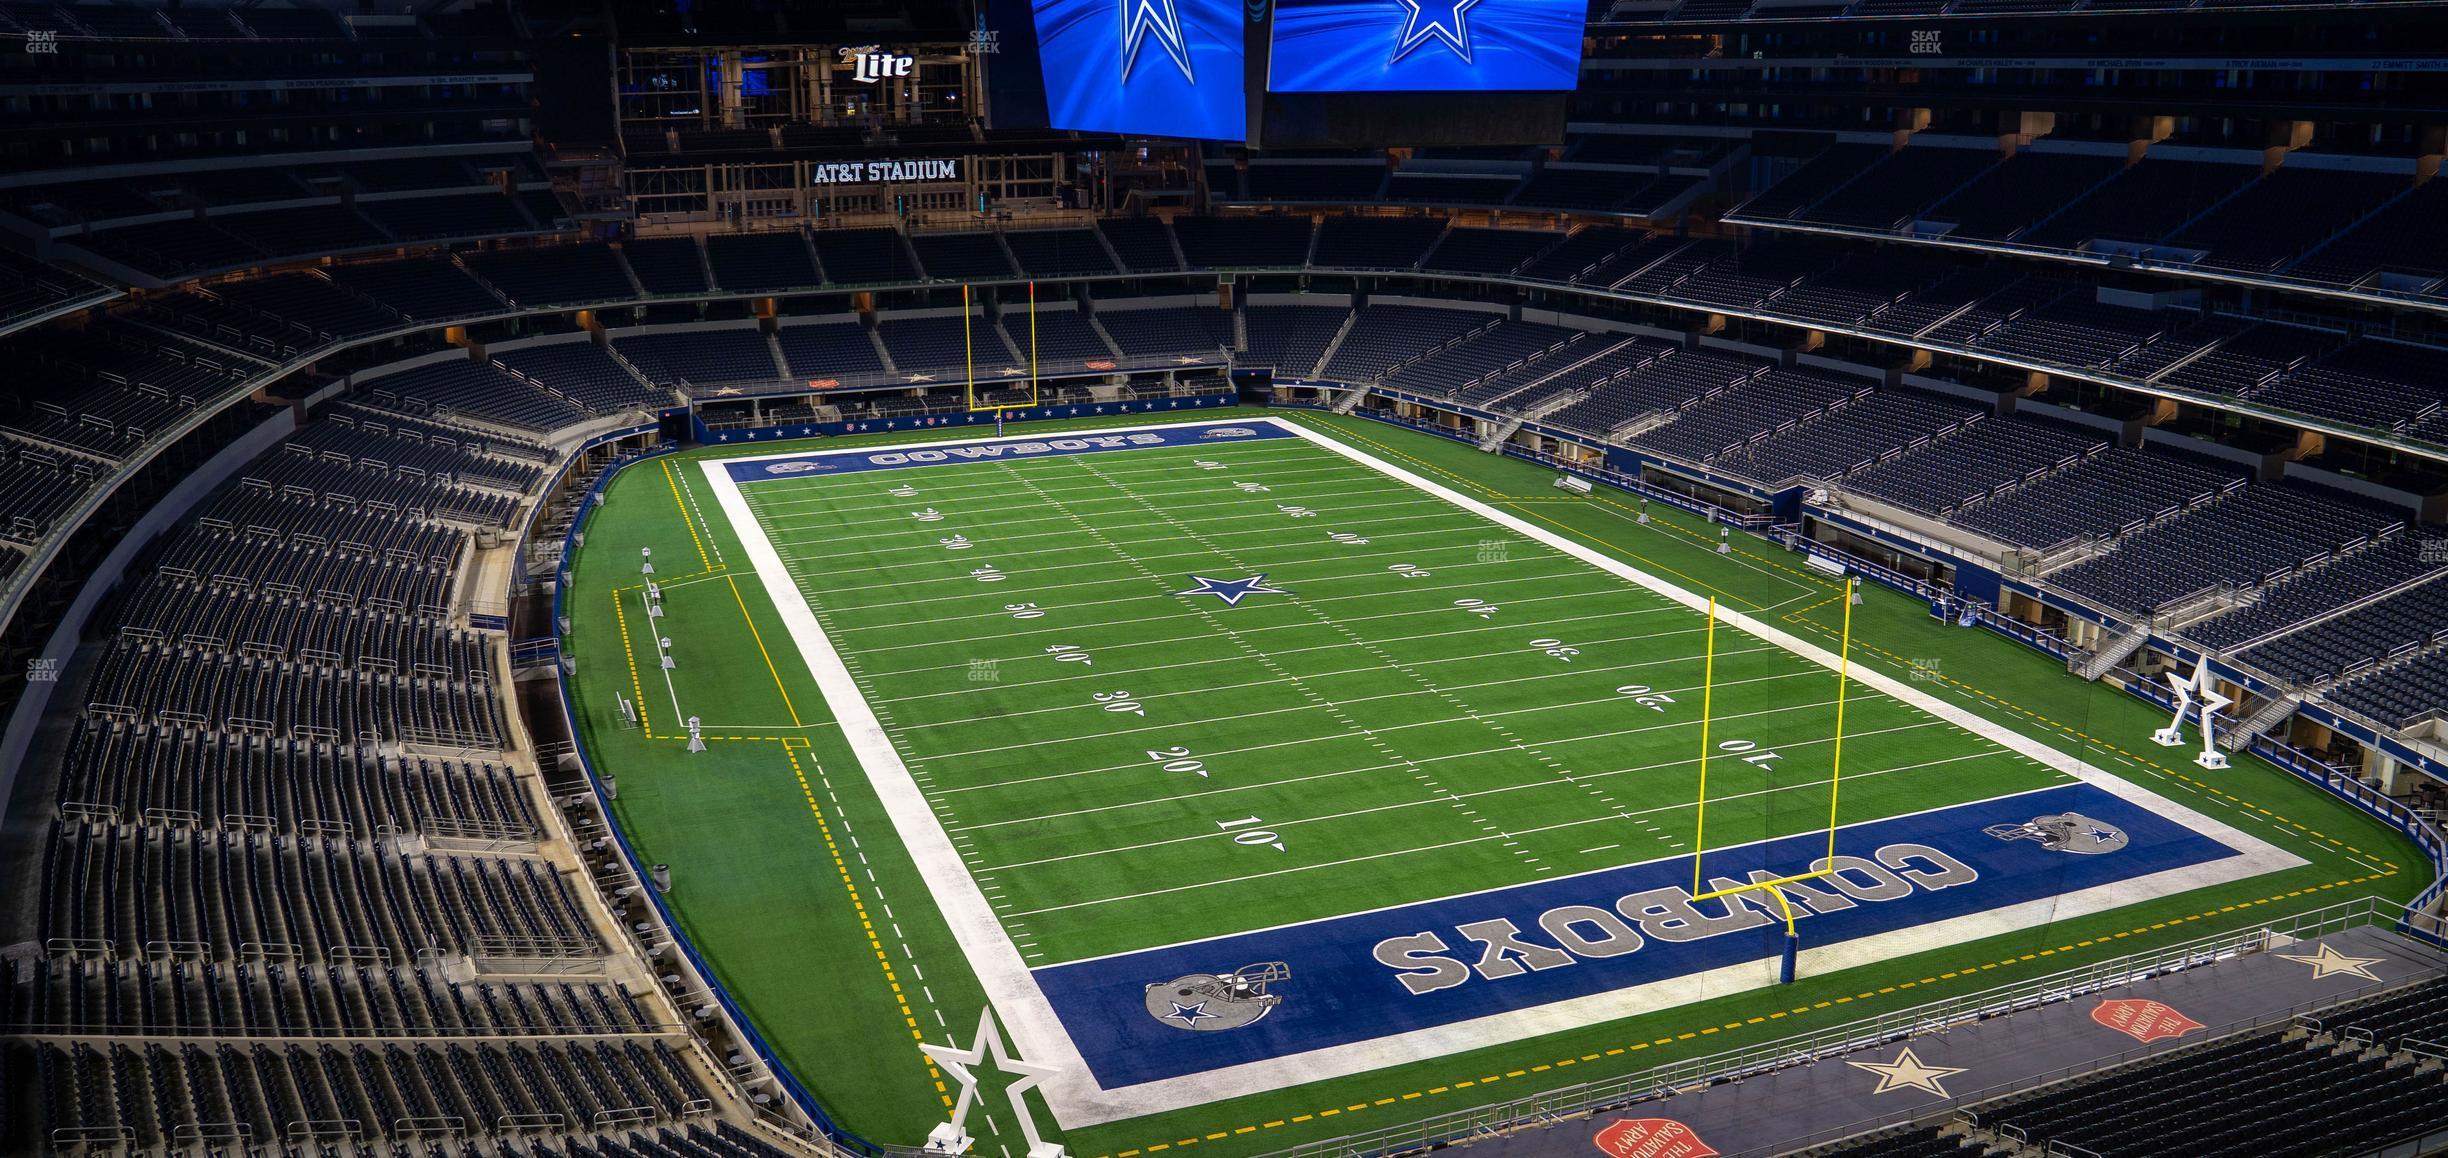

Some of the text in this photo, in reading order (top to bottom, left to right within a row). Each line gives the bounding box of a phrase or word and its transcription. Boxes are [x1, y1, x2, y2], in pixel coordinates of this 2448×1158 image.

[852, 53, 913, 83] Lite
[814, 160, 956, 184] AT&T STADIUM
[867, 433, 1166, 466] COWBOYS
[940, 536, 974, 550] 30
[1331, 533, 1370, 545] 40
[970, 568, 1007, 582] 40
[1388, 564, 1431, 578] 50
[1005, 603, 1045, 619] 50
[1454, 599, 1500, 613] 40
[1045, 645, 1089, 662] 40
[1529, 638, 1580, 657] 30
[1092, 690, 1142, 712] 30
[1616, 685, 1677, 706] 20
[1146, 746, 1204, 772] 20
[1718, 740, 1783, 765] 10
[1216, 815, 1279, 845] 10
[1372, 843, 1979, 996] COWBOYS
[2110, 1001, 2137, 1027] ARMY
[2129, 1002, 2167, 1039] SALVATION
[2158, 1016, 2182, 1034] THE
[1614, 1121, 1649, 1155] ARMY
